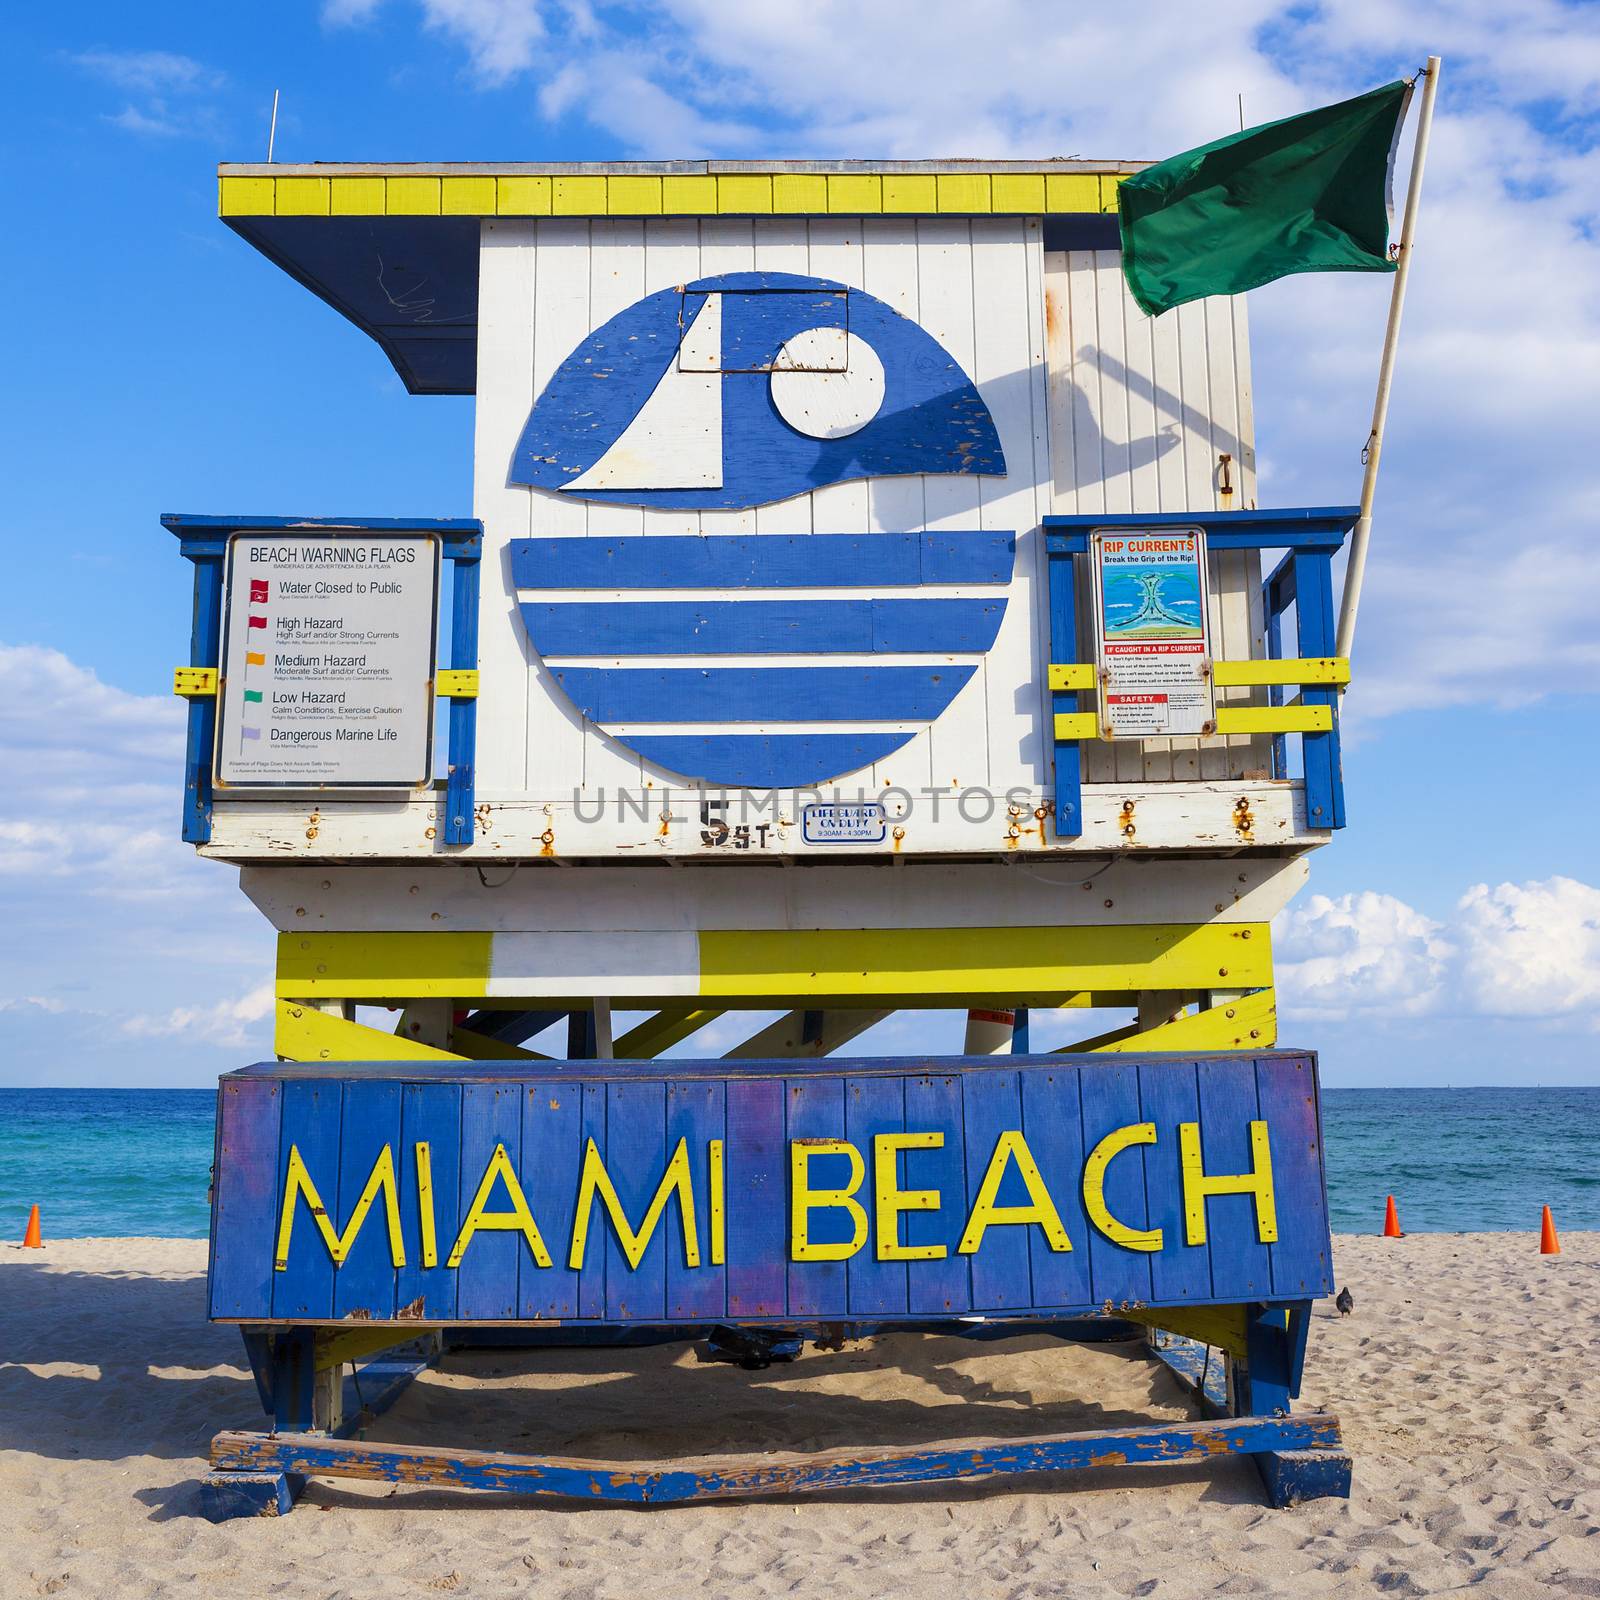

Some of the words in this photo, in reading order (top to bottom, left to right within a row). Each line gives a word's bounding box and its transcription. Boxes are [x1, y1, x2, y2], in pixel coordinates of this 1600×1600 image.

[1104, 542, 1123, 553] RIP
[1127, 540, 1194, 552] CURRENTS
[250, 547, 297, 563] BEACH
[301, 547, 367, 563] WARNING
[371, 547, 416, 563] FLAGS
[279, 581, 312, 594] Water
[315, 581, 352, 594] Closed
[355, 581, 367, 594] to
[370, 581, 403, 594] Public
[276, 616, 301, 632] High
[304, 616, 344, 629] Hazard
[276, 631, 293, 640] High
[295, 631, 311, 640] Surf
[313, 631, 338, 640] and/or
[340, 631, 365, 640] Strong
[367, 631, 400, 640] Currents
[274, 654, 321, 667] Medium
[324, 654, 367, 667] Hazard
[274, 667, 311, 676] Moderate
[313, 667, 328, 676] Surf
[330, 667, 355, 676] and/or
[357, 667, 390, 676] Currents
[272, 691, 298, 704] Low
[302, 691, 346, 704] Hazard
[272, 706, 292, 715] Calm
[294, 706, 336, 715] Conditions,
[338, 706, 371, 715] Exercise
[373, 706, 403, 715] Caution
[270, 728, 333, 744] Dangerous
[336, 728, 375, 740] Marine
[378, 728, 398, 740] Life
[820, 819, 836, 828] ON
[839, 819, 868, 828] DUTY
[274, 1136, 725, 1272] MIAMI
[791, 1120, 1279, 1261] BEACH
